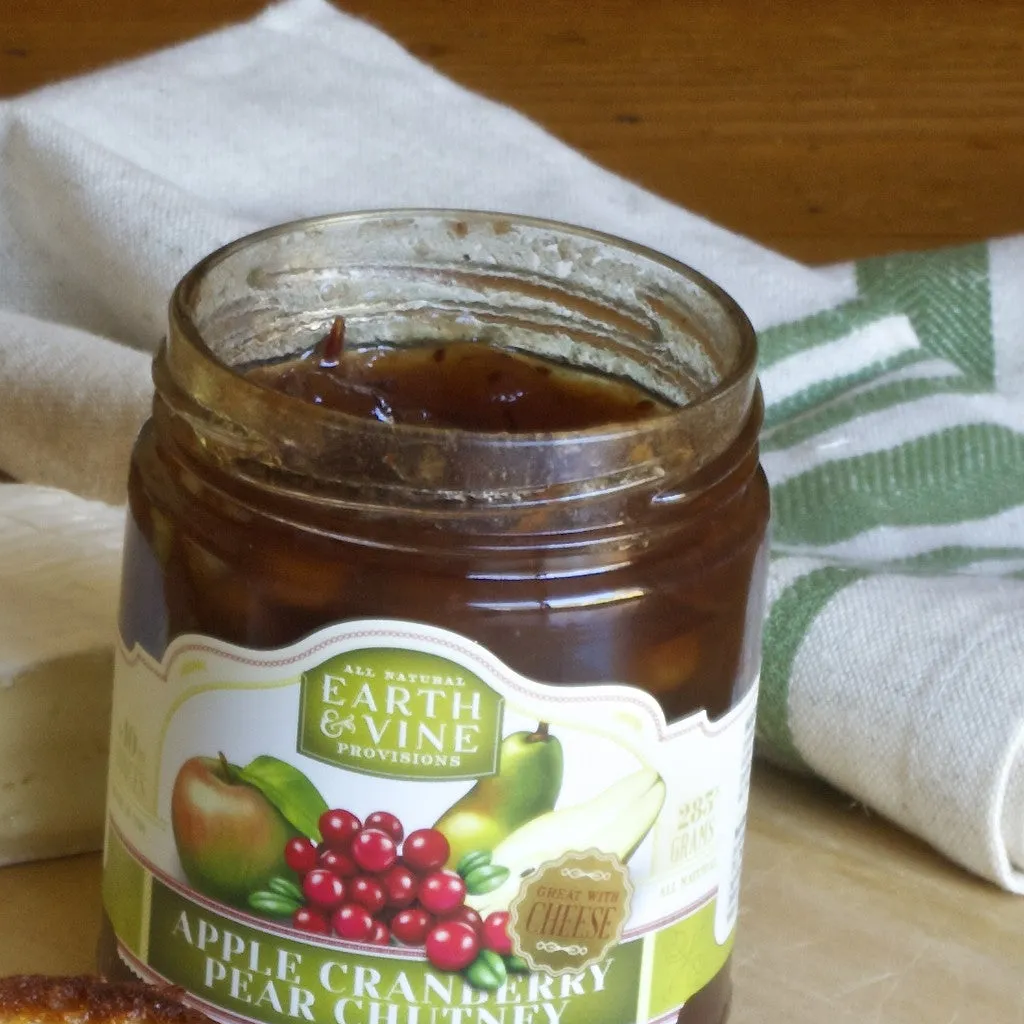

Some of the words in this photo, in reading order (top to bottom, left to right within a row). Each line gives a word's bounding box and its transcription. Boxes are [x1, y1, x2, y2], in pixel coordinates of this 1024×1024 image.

[343, 664, 376, 678] ALL
[384, 671, 466, 687] NATURAL
[321, 674, 482, 721] EARTH
[337, 742, 462, 767] PROVISIONS
[536, 886, 582, 900] GREAT
[587, 889, 620, 903] WITH
[526, 901, 617, 940] CHEESE
[173, 910, 302, 985] APPLE
[204, 956, 316, 1022] PEAR
